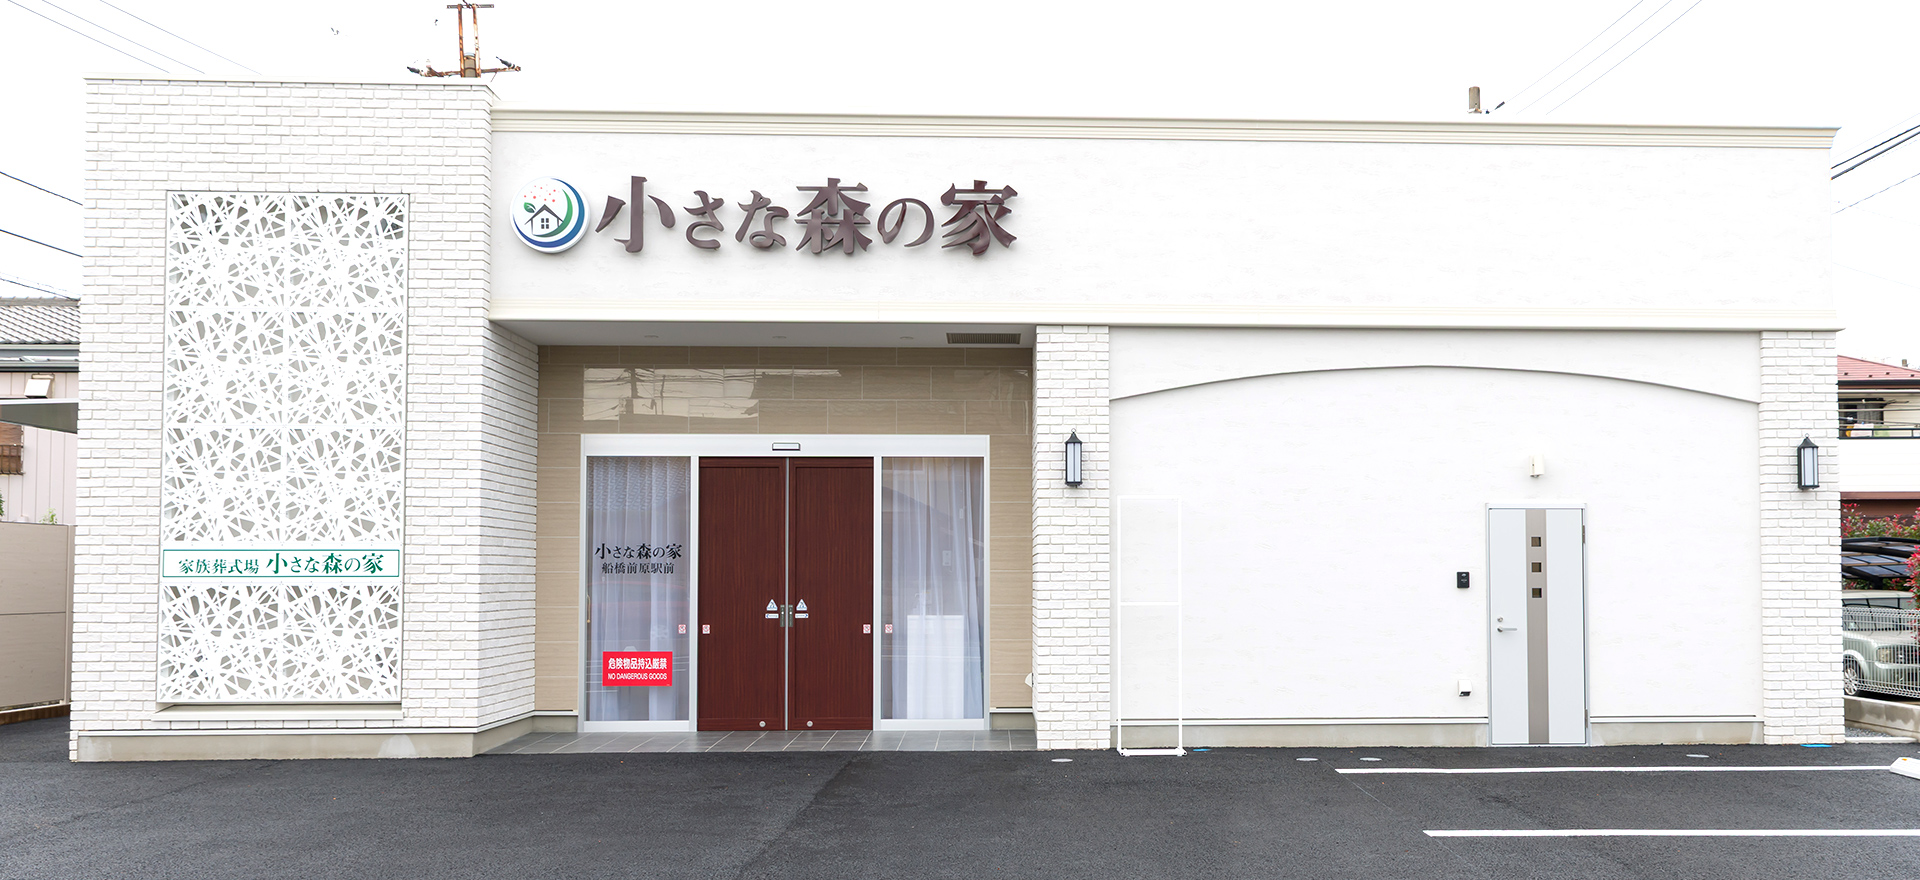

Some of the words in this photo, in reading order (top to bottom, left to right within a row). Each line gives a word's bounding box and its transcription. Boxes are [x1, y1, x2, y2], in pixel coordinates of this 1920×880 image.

[594, 175, 1018, 256] 小さな森の家
[594, 543, 682, 560] 小さな森の家
[178, 559, 259, 574] 家族葬式場
[266, 552, 384, 575] 小さな森の家
[601, 562, 675, 574] 船橋前原駅前
[608, 672, 616, 680] NO
[616, 672, 648, 680] DANGEROUS
[648, 672, 668, 680] GOODS
